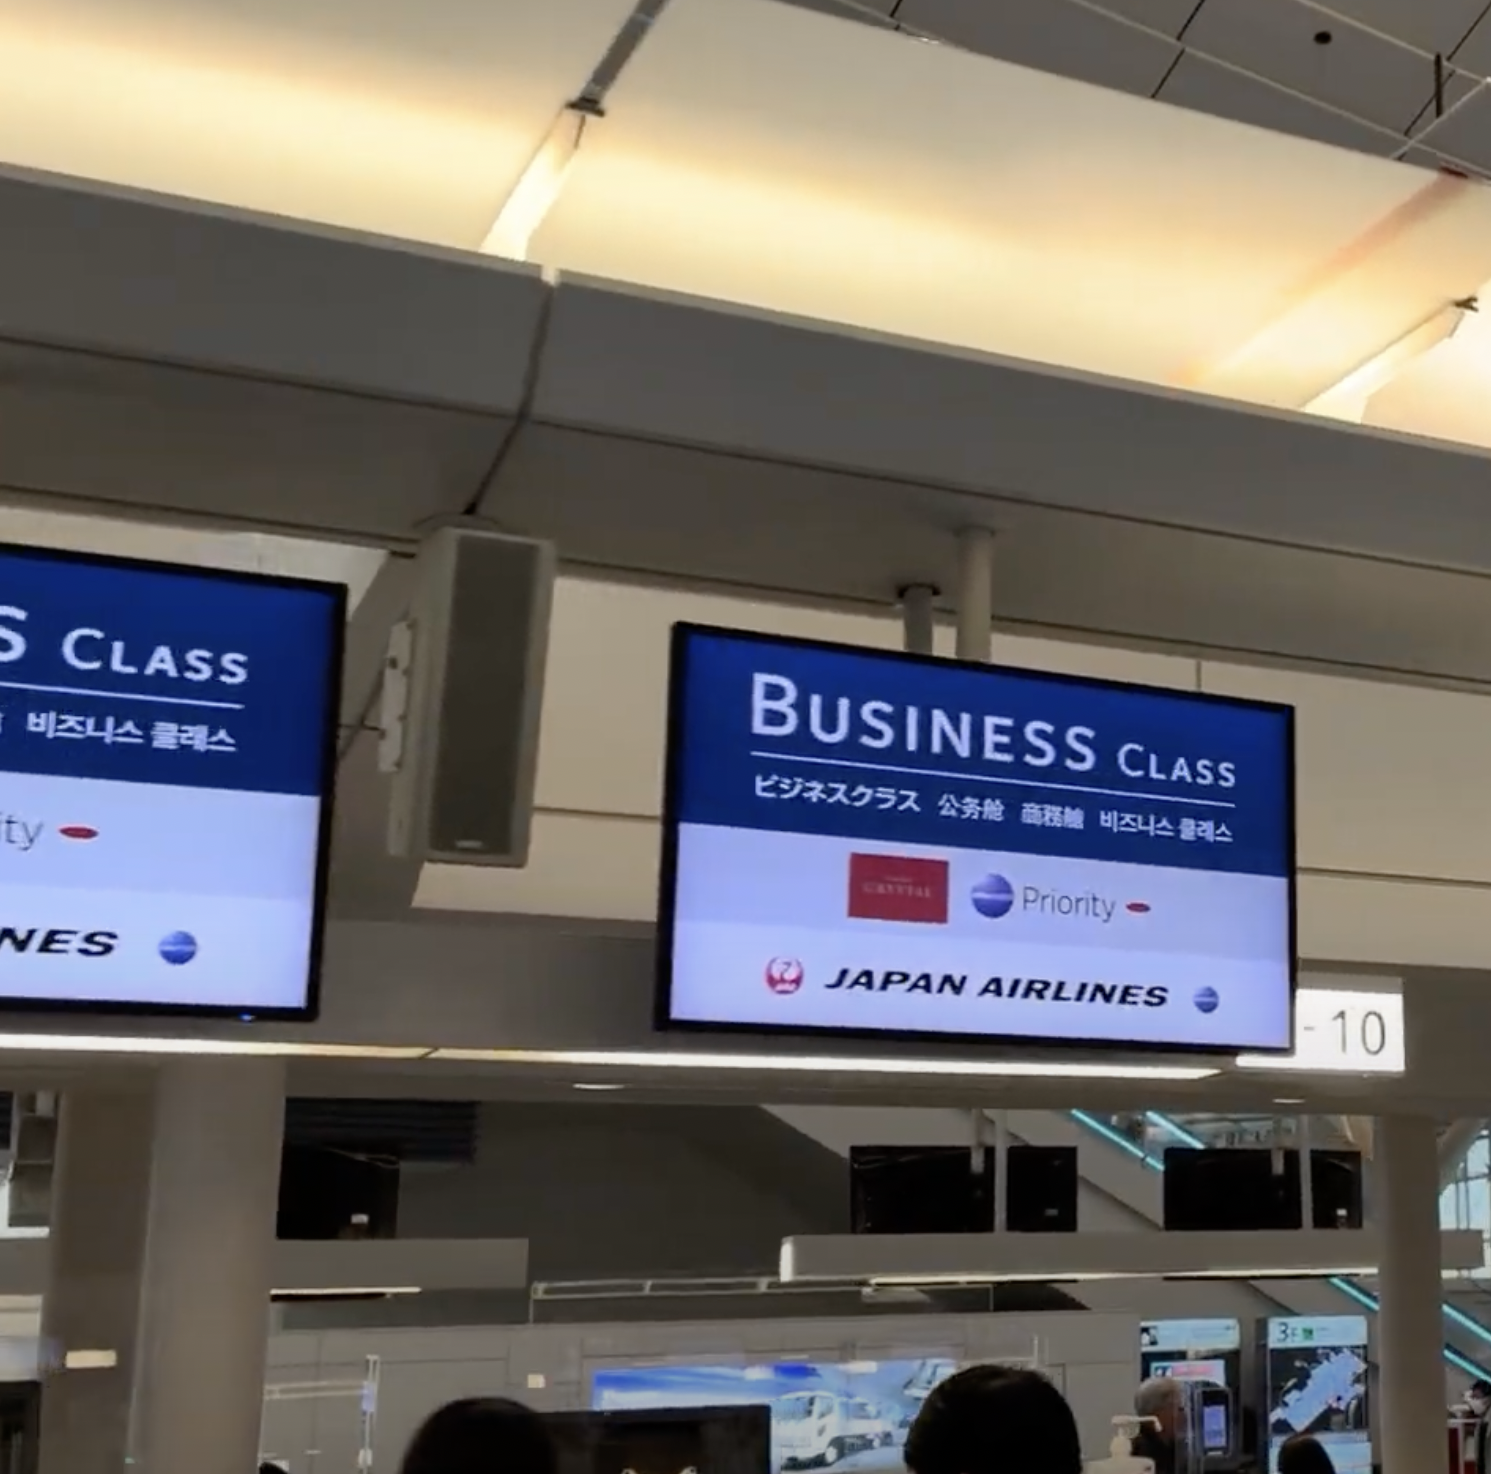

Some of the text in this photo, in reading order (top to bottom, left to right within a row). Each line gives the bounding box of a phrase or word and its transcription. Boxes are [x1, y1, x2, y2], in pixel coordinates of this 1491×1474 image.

[62, 627, 248, 684] CLASS
[27, 710, 237, 752] 비즈니스 클래스
[751, 671, 1236, 787] BUSINESS CLASS
[754, 773, 921, 813] ビジネスクラス
[1099, 809, 1176, 837] 비즈니스
[1022, 885, 1116, 924] Priority
[823, 967, 1169, 1008] JAPAN AIRLINES
